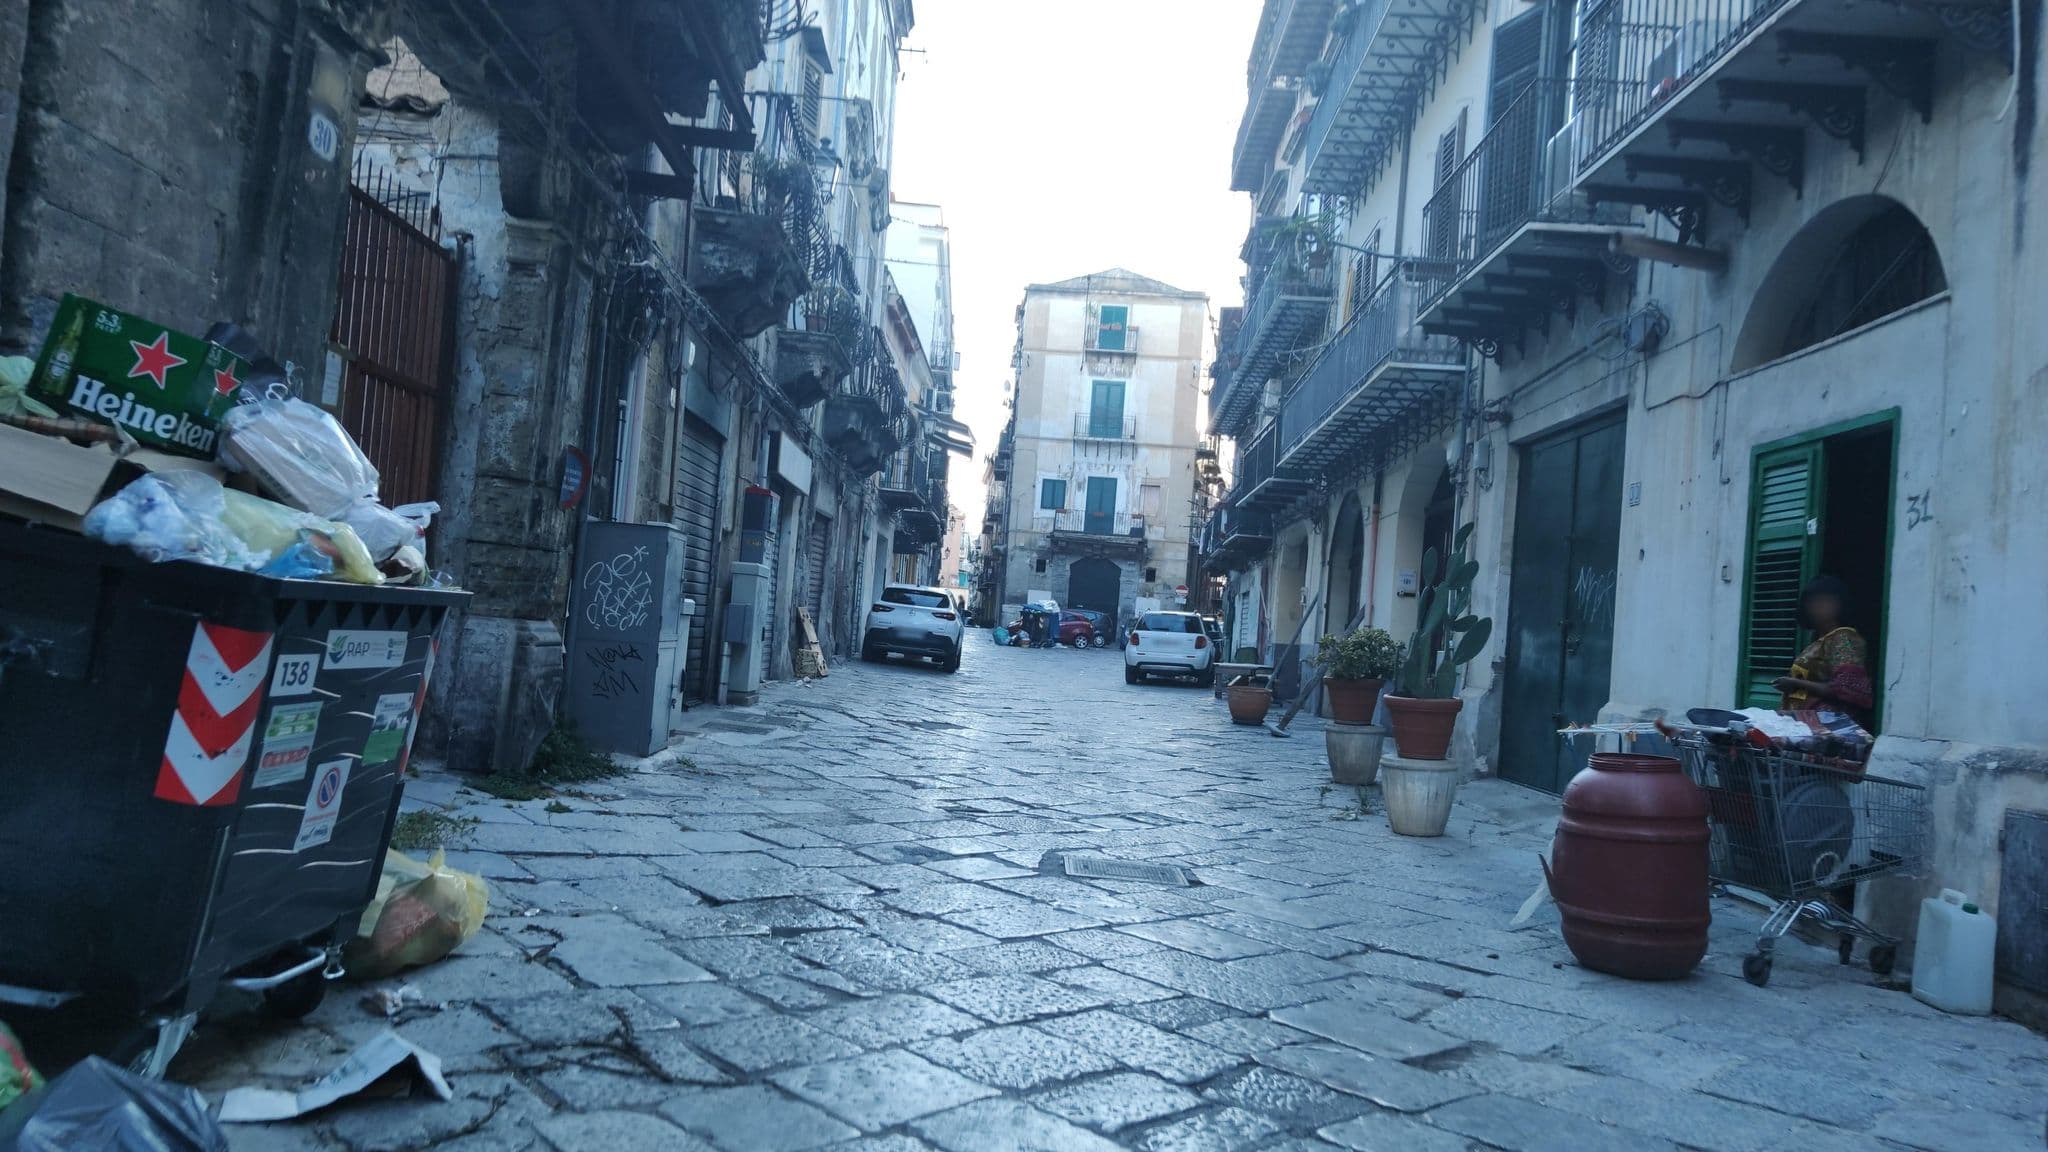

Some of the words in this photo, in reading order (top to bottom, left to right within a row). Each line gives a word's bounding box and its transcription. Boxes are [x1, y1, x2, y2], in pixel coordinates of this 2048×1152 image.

[314, 119, 333, 154] 30
[68, 374, 216, 452] Heineken
[1906, 487, 1934, 532] 31
[346, 641, 370, 657] RAP
[280, 660, 310, 687] 138
